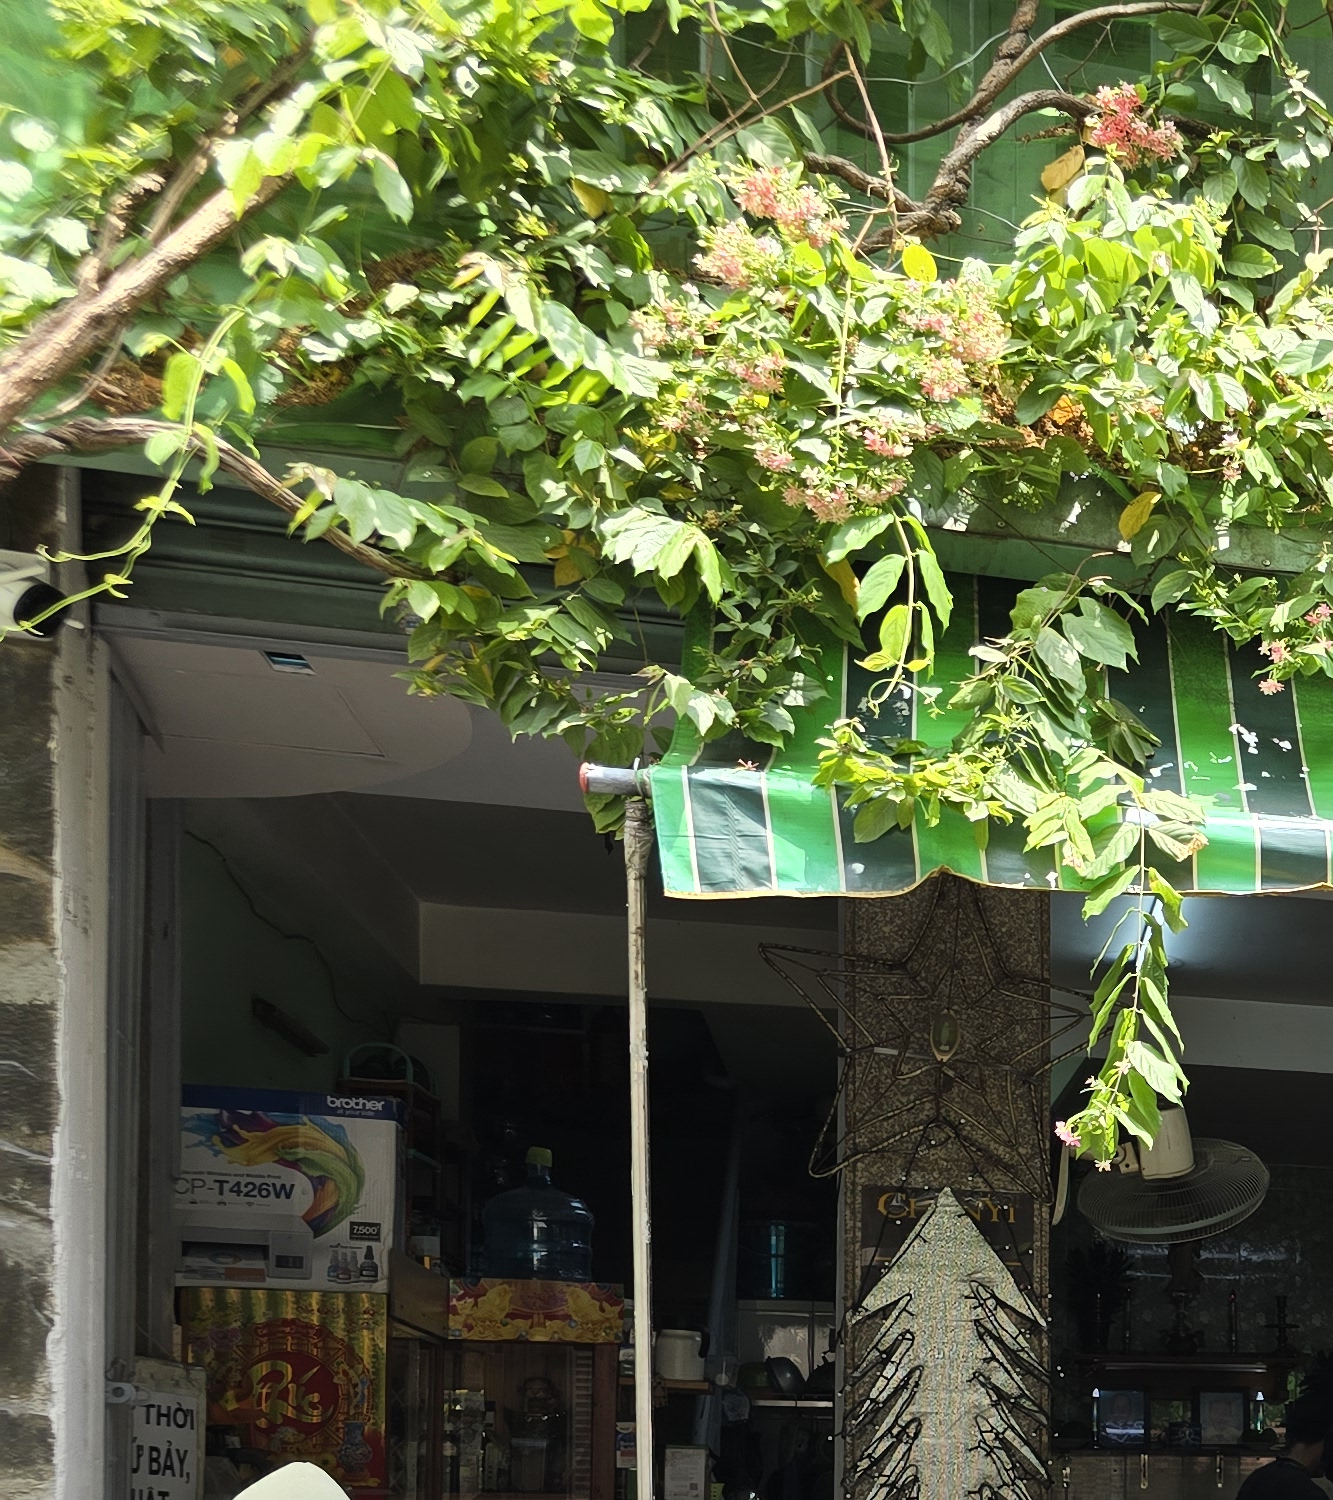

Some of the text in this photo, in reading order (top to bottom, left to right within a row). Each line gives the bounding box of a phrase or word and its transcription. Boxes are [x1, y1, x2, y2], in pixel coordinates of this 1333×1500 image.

[327, 1096, 385, 1111] brother
[175, 1177, 295, 1200] CP-T426W
[142, 1402, 195, 1430] THỜI
[148, 1440, 191, 1484] BẢY,
